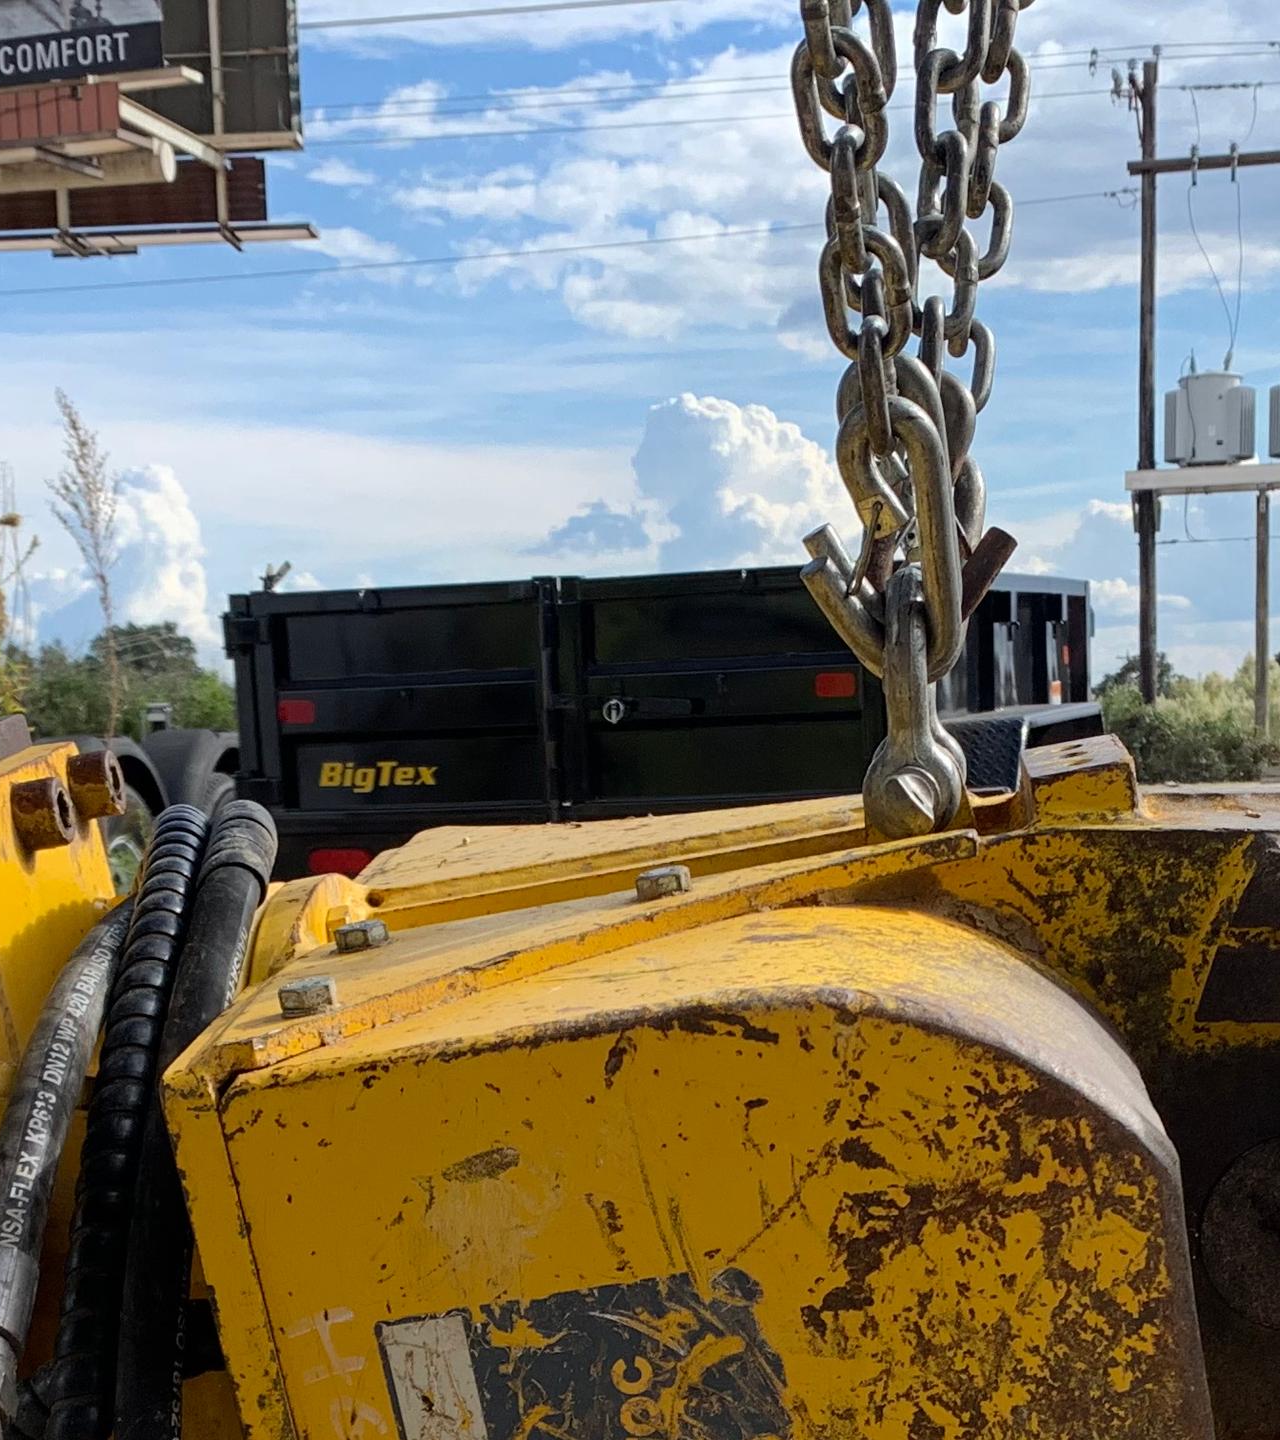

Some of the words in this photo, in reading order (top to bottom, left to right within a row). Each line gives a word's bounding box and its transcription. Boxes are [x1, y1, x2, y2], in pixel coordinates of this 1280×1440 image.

[319, 761, 438, 793] BigTex
[90, 946, 113, 971] ISO
[75, 967, 103, 995] BAR
[66, 993, 90, 1018] 420
[55, 1018, 78, 1042] WP
[43, 1043, 70, 1086] DN12
